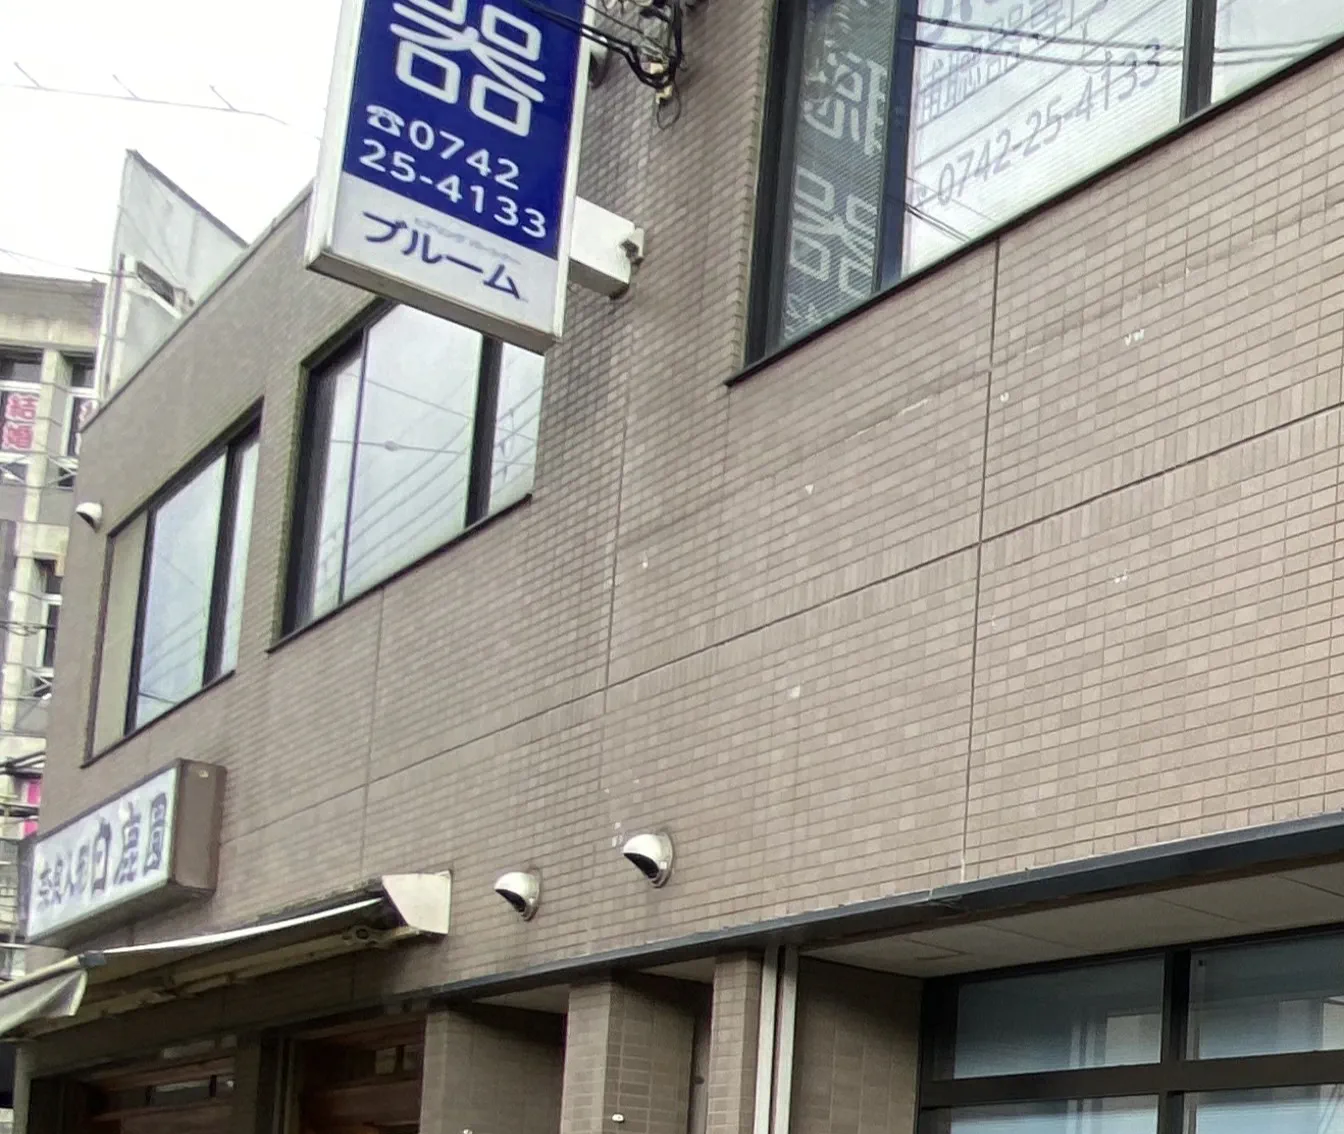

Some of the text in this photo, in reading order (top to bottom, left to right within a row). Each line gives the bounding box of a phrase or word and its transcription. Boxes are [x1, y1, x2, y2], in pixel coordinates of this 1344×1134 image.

[359, 138, 547, 239] 25-4133
[408, 119, 520, 191] 0742
[362, 211, 521, 300] ブルーム
